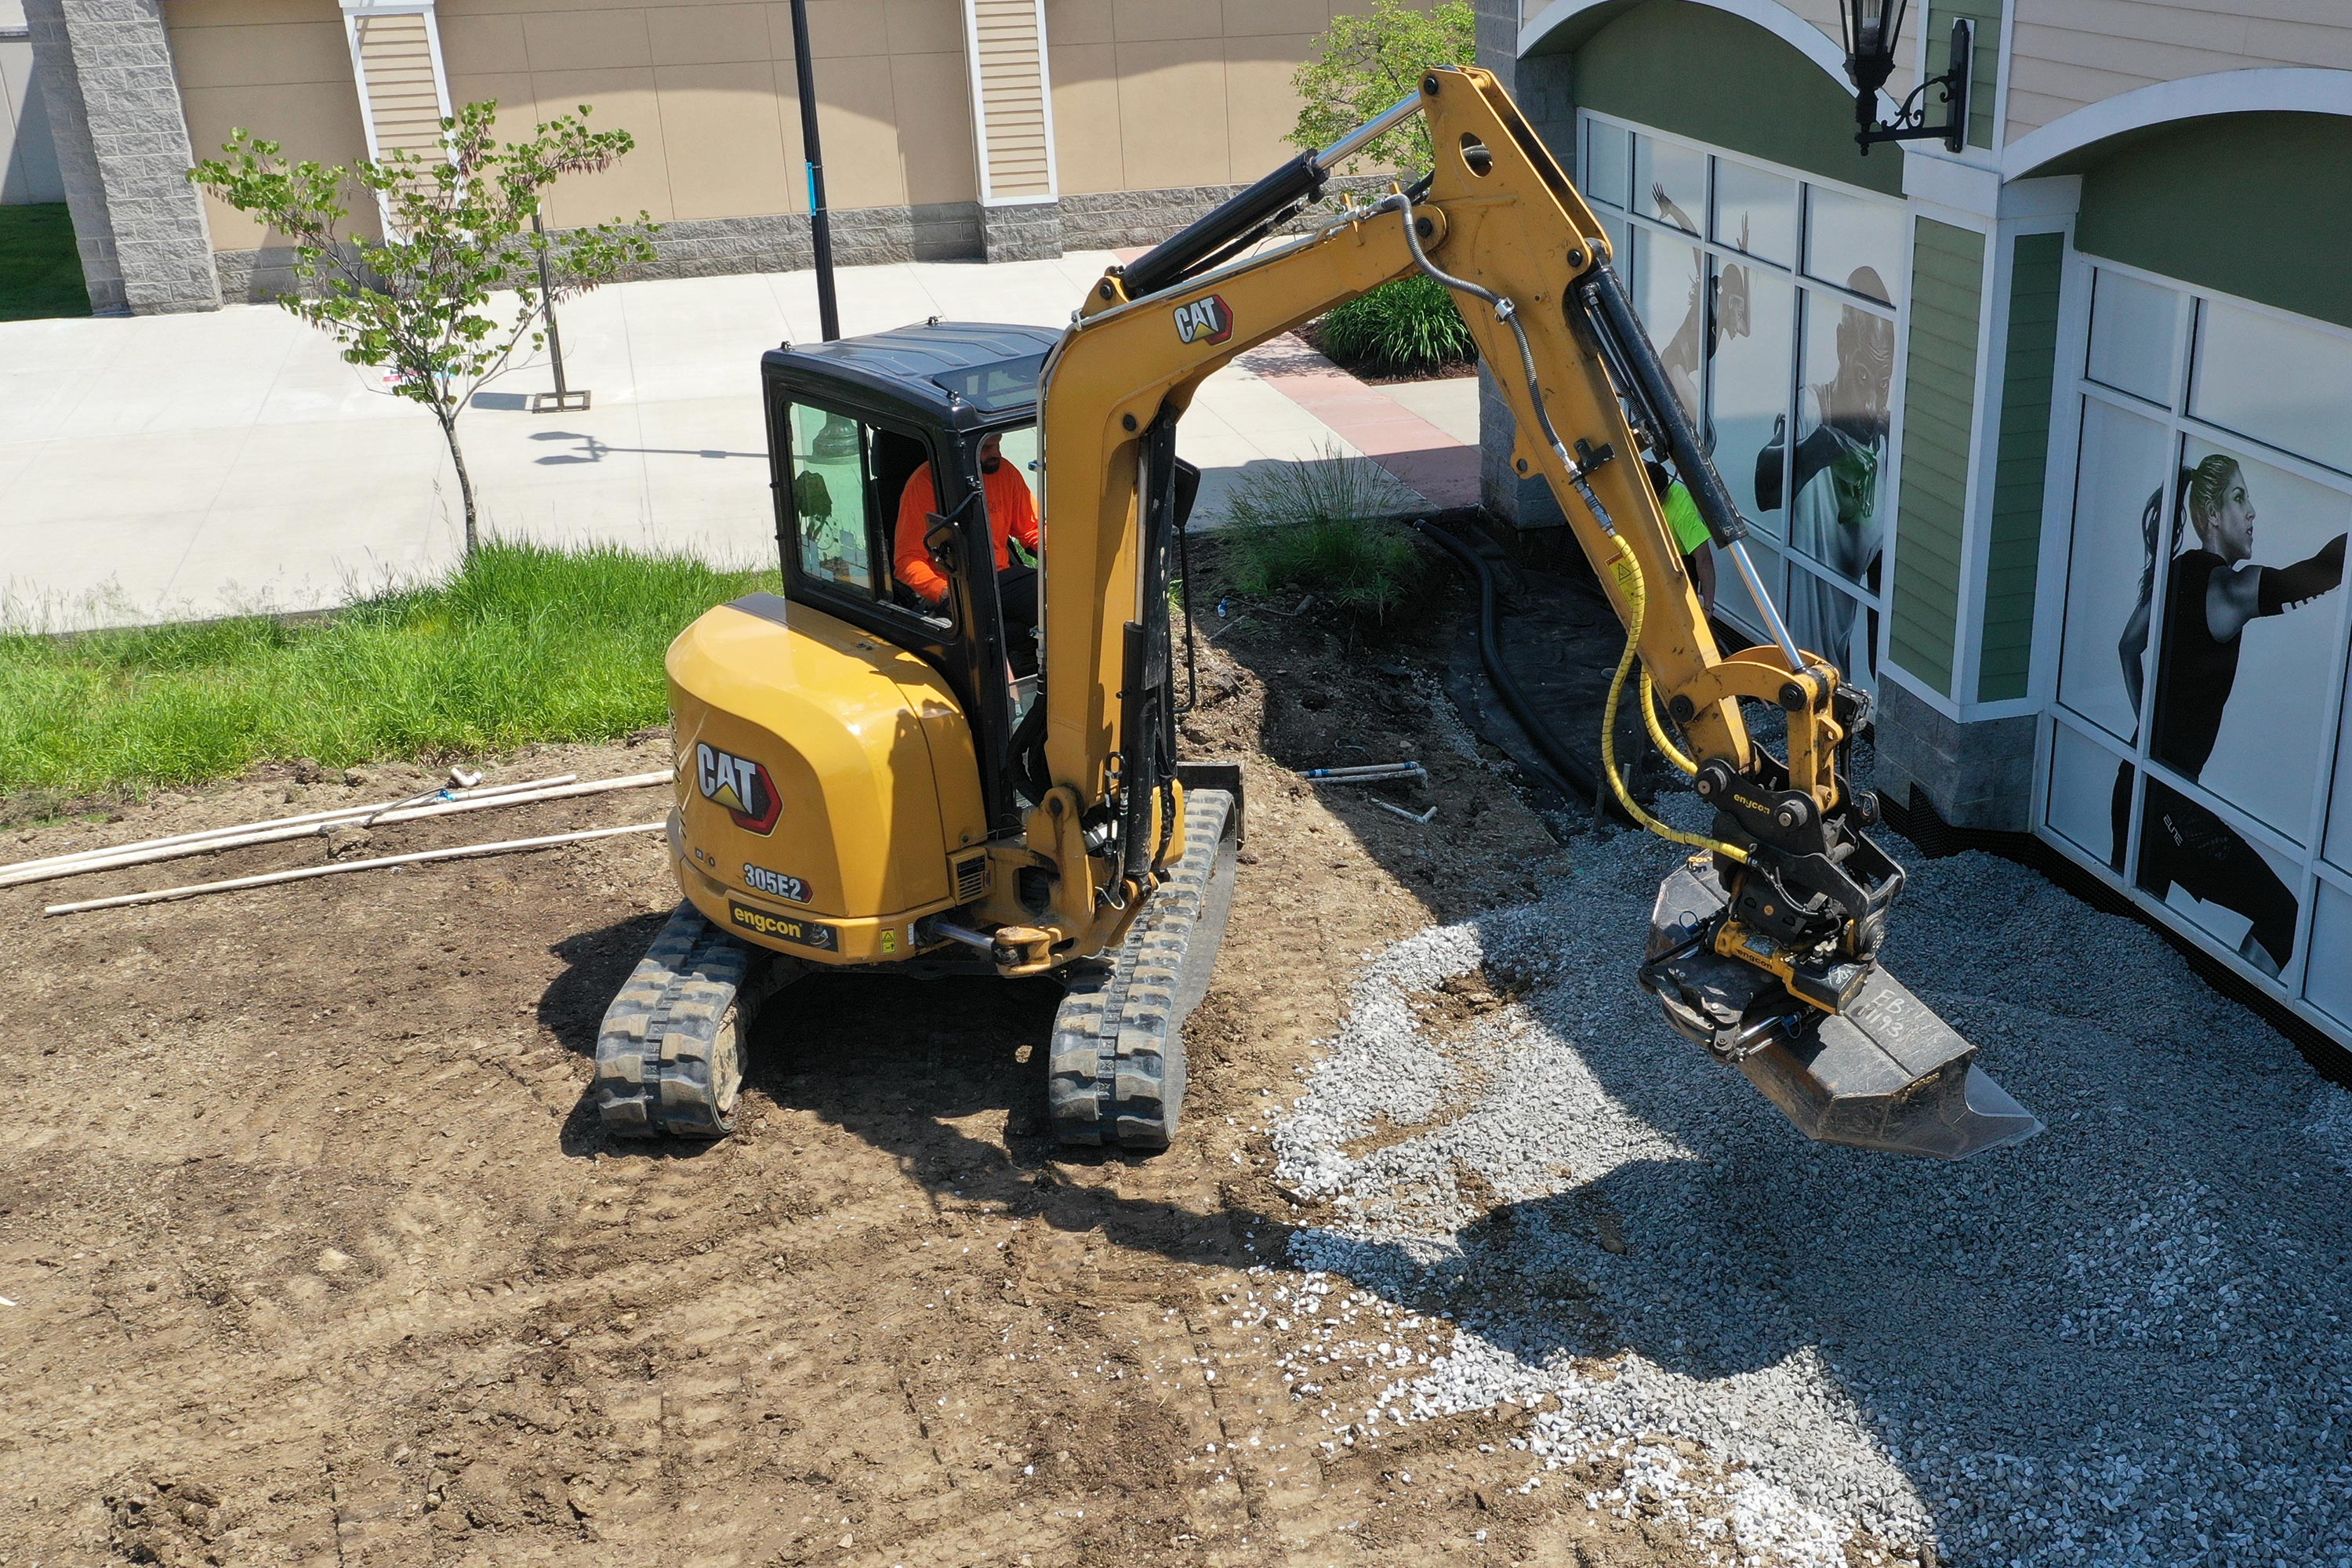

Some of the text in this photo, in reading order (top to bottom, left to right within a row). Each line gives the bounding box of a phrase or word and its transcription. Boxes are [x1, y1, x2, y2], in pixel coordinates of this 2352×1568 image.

[1174, 297, 1219, 343] CAT
[697, 743, 756, 815] CAT
[744, 863, 802, 901] 305E2
[734, 908, 801, 938] engcon
[1737, 949, 1773, 970] engcon
